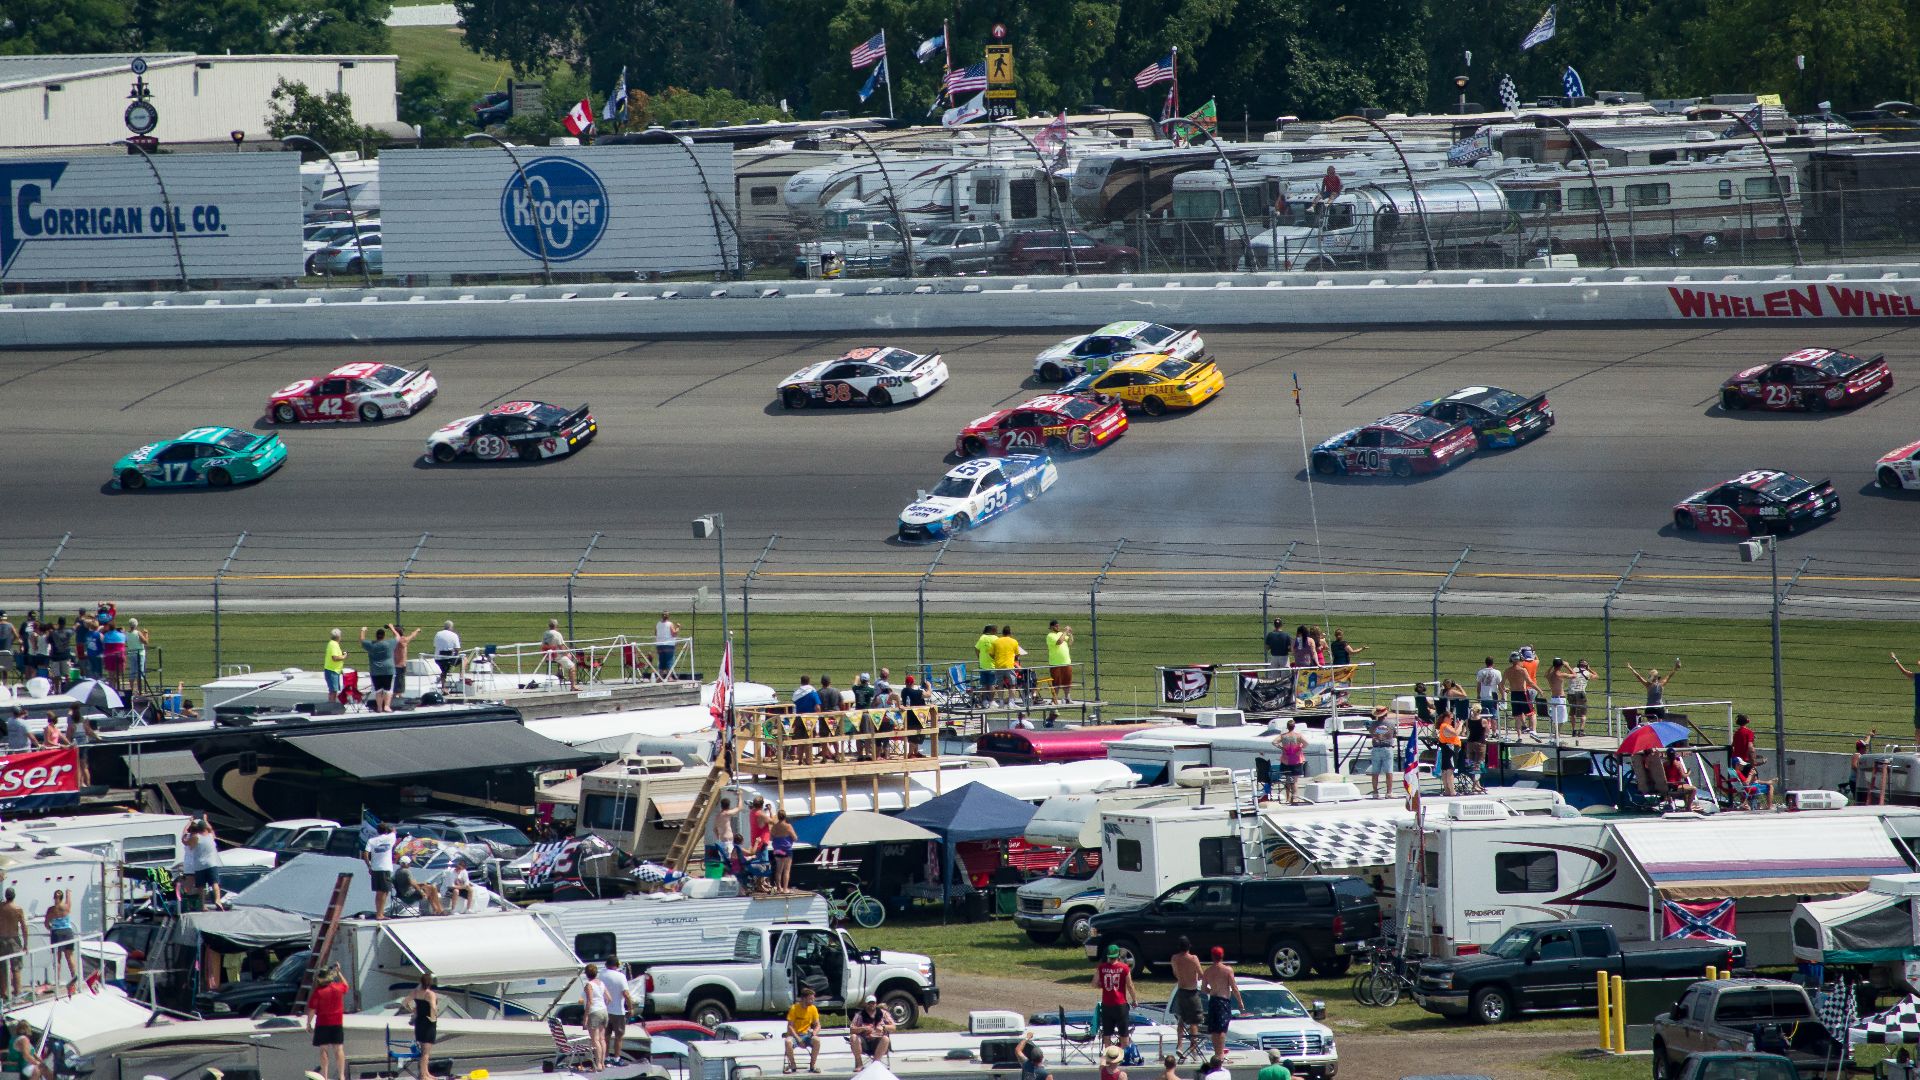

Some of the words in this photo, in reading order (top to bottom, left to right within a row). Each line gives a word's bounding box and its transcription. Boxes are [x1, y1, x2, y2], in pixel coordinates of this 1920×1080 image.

[18, 183, 143, 236] CORRIGAN
[151, 206, 186, 233] OIL
[193, 205, 226, 232] CO.
[513, 175, 600, 249] Kroger
[1668, 284, 1823, 317] WHELEN
[824, 383, 851, 403] 38
[1766, 385, 1787, 405] 23
[318, 398, 343, 415] 42
[1006, 431, 1033, 450] 26
[1043, 427, 1067, 436] ESTES
[476, 436, 500, 455] 83
[956, 460, 991, 476] 55
[1356, 450, 1379, 470] 40
[163, 463, 188, 482] 17
[984, 488, 1008, 514] 55
[1710, 509, 1733, 527] 35
[0, 760, 72, 791] ser
[813, 847, 840, 868] 41
[1464, 909, 1506, 917] WINDSPORT
